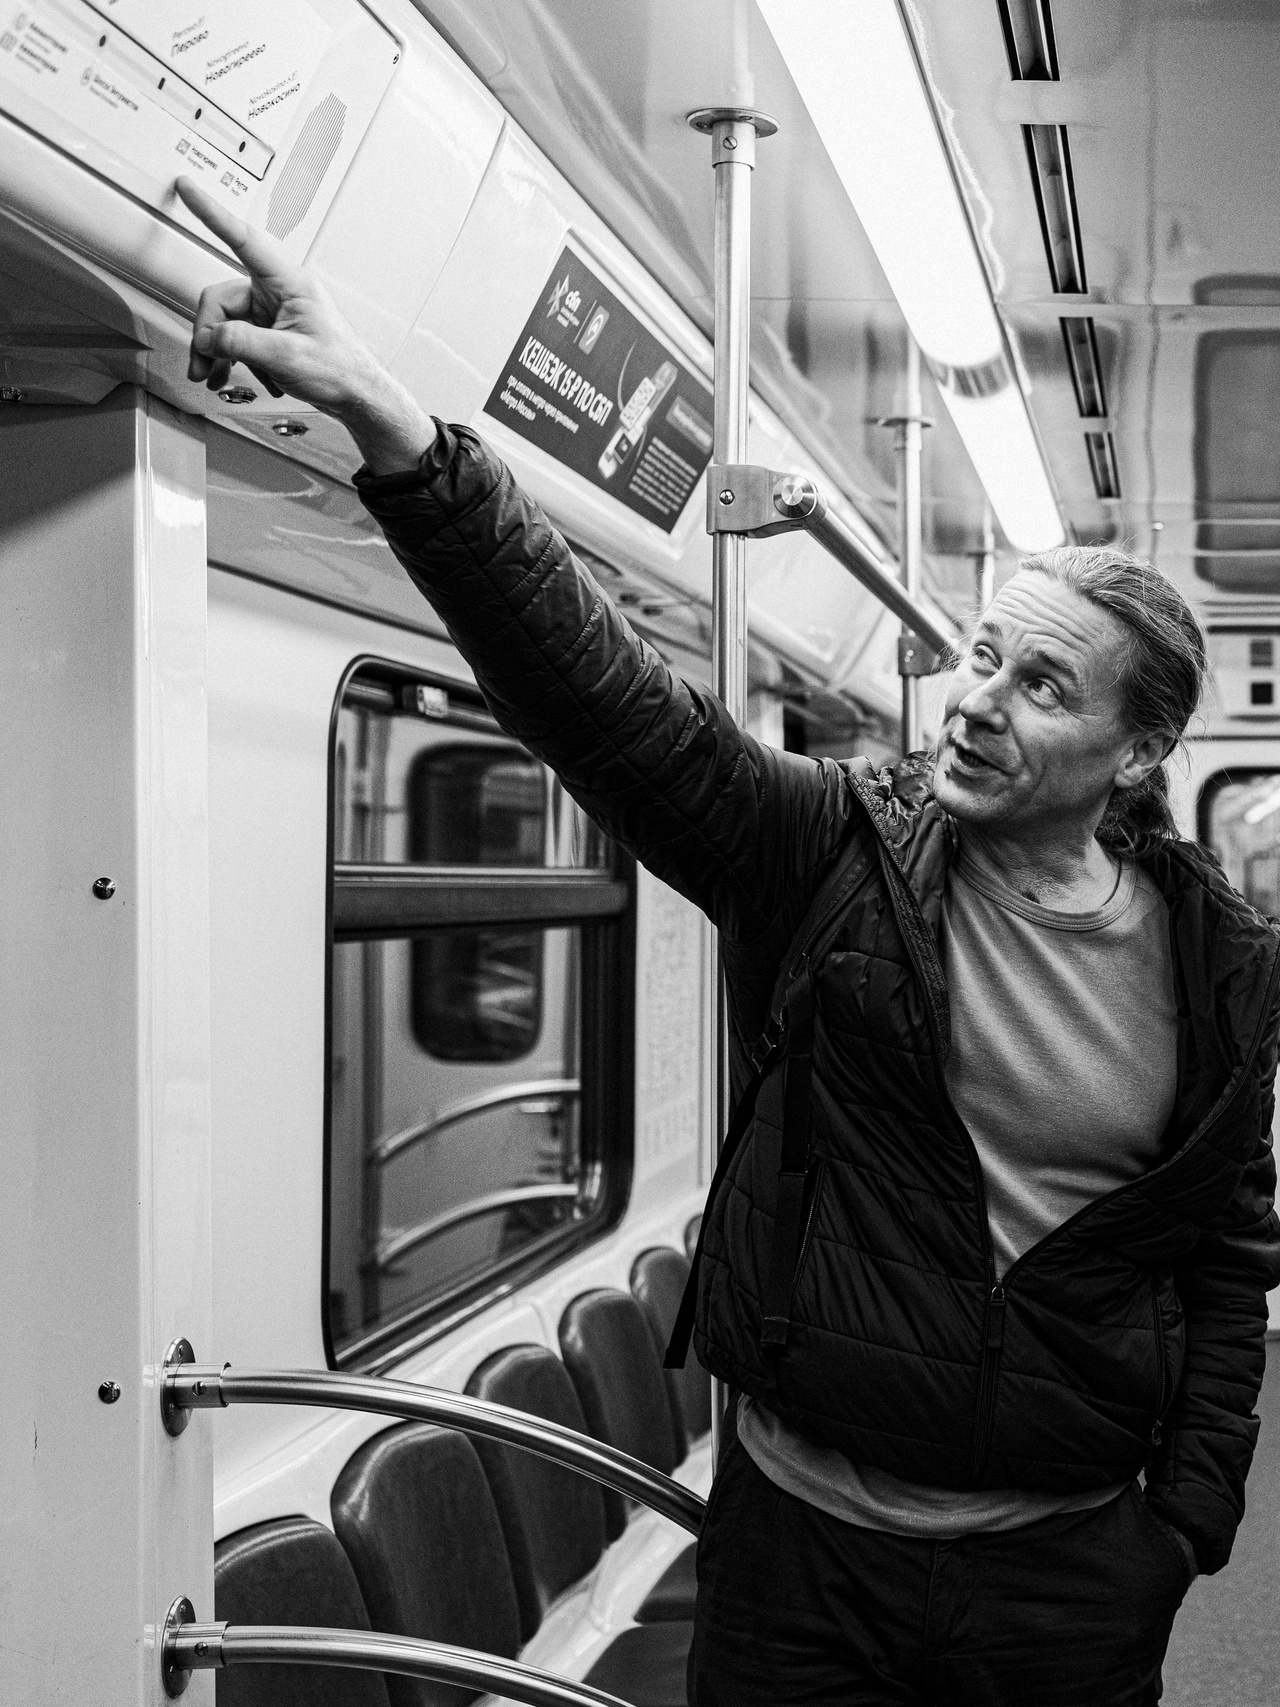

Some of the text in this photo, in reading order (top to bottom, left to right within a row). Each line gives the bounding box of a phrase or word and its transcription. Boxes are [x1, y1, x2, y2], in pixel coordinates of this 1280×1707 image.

[171, 30, 209, 58] Перово
[205, 44, 266, 85] Новогиреево
[248, 83, 300, 120] Новокосино
[565, 290, 582, 313] сбп
[518, 335, 568, 390] КЕШБЭК
[573, 380, 596, 412] ПО
[588, 392, 614, 427] СБП
